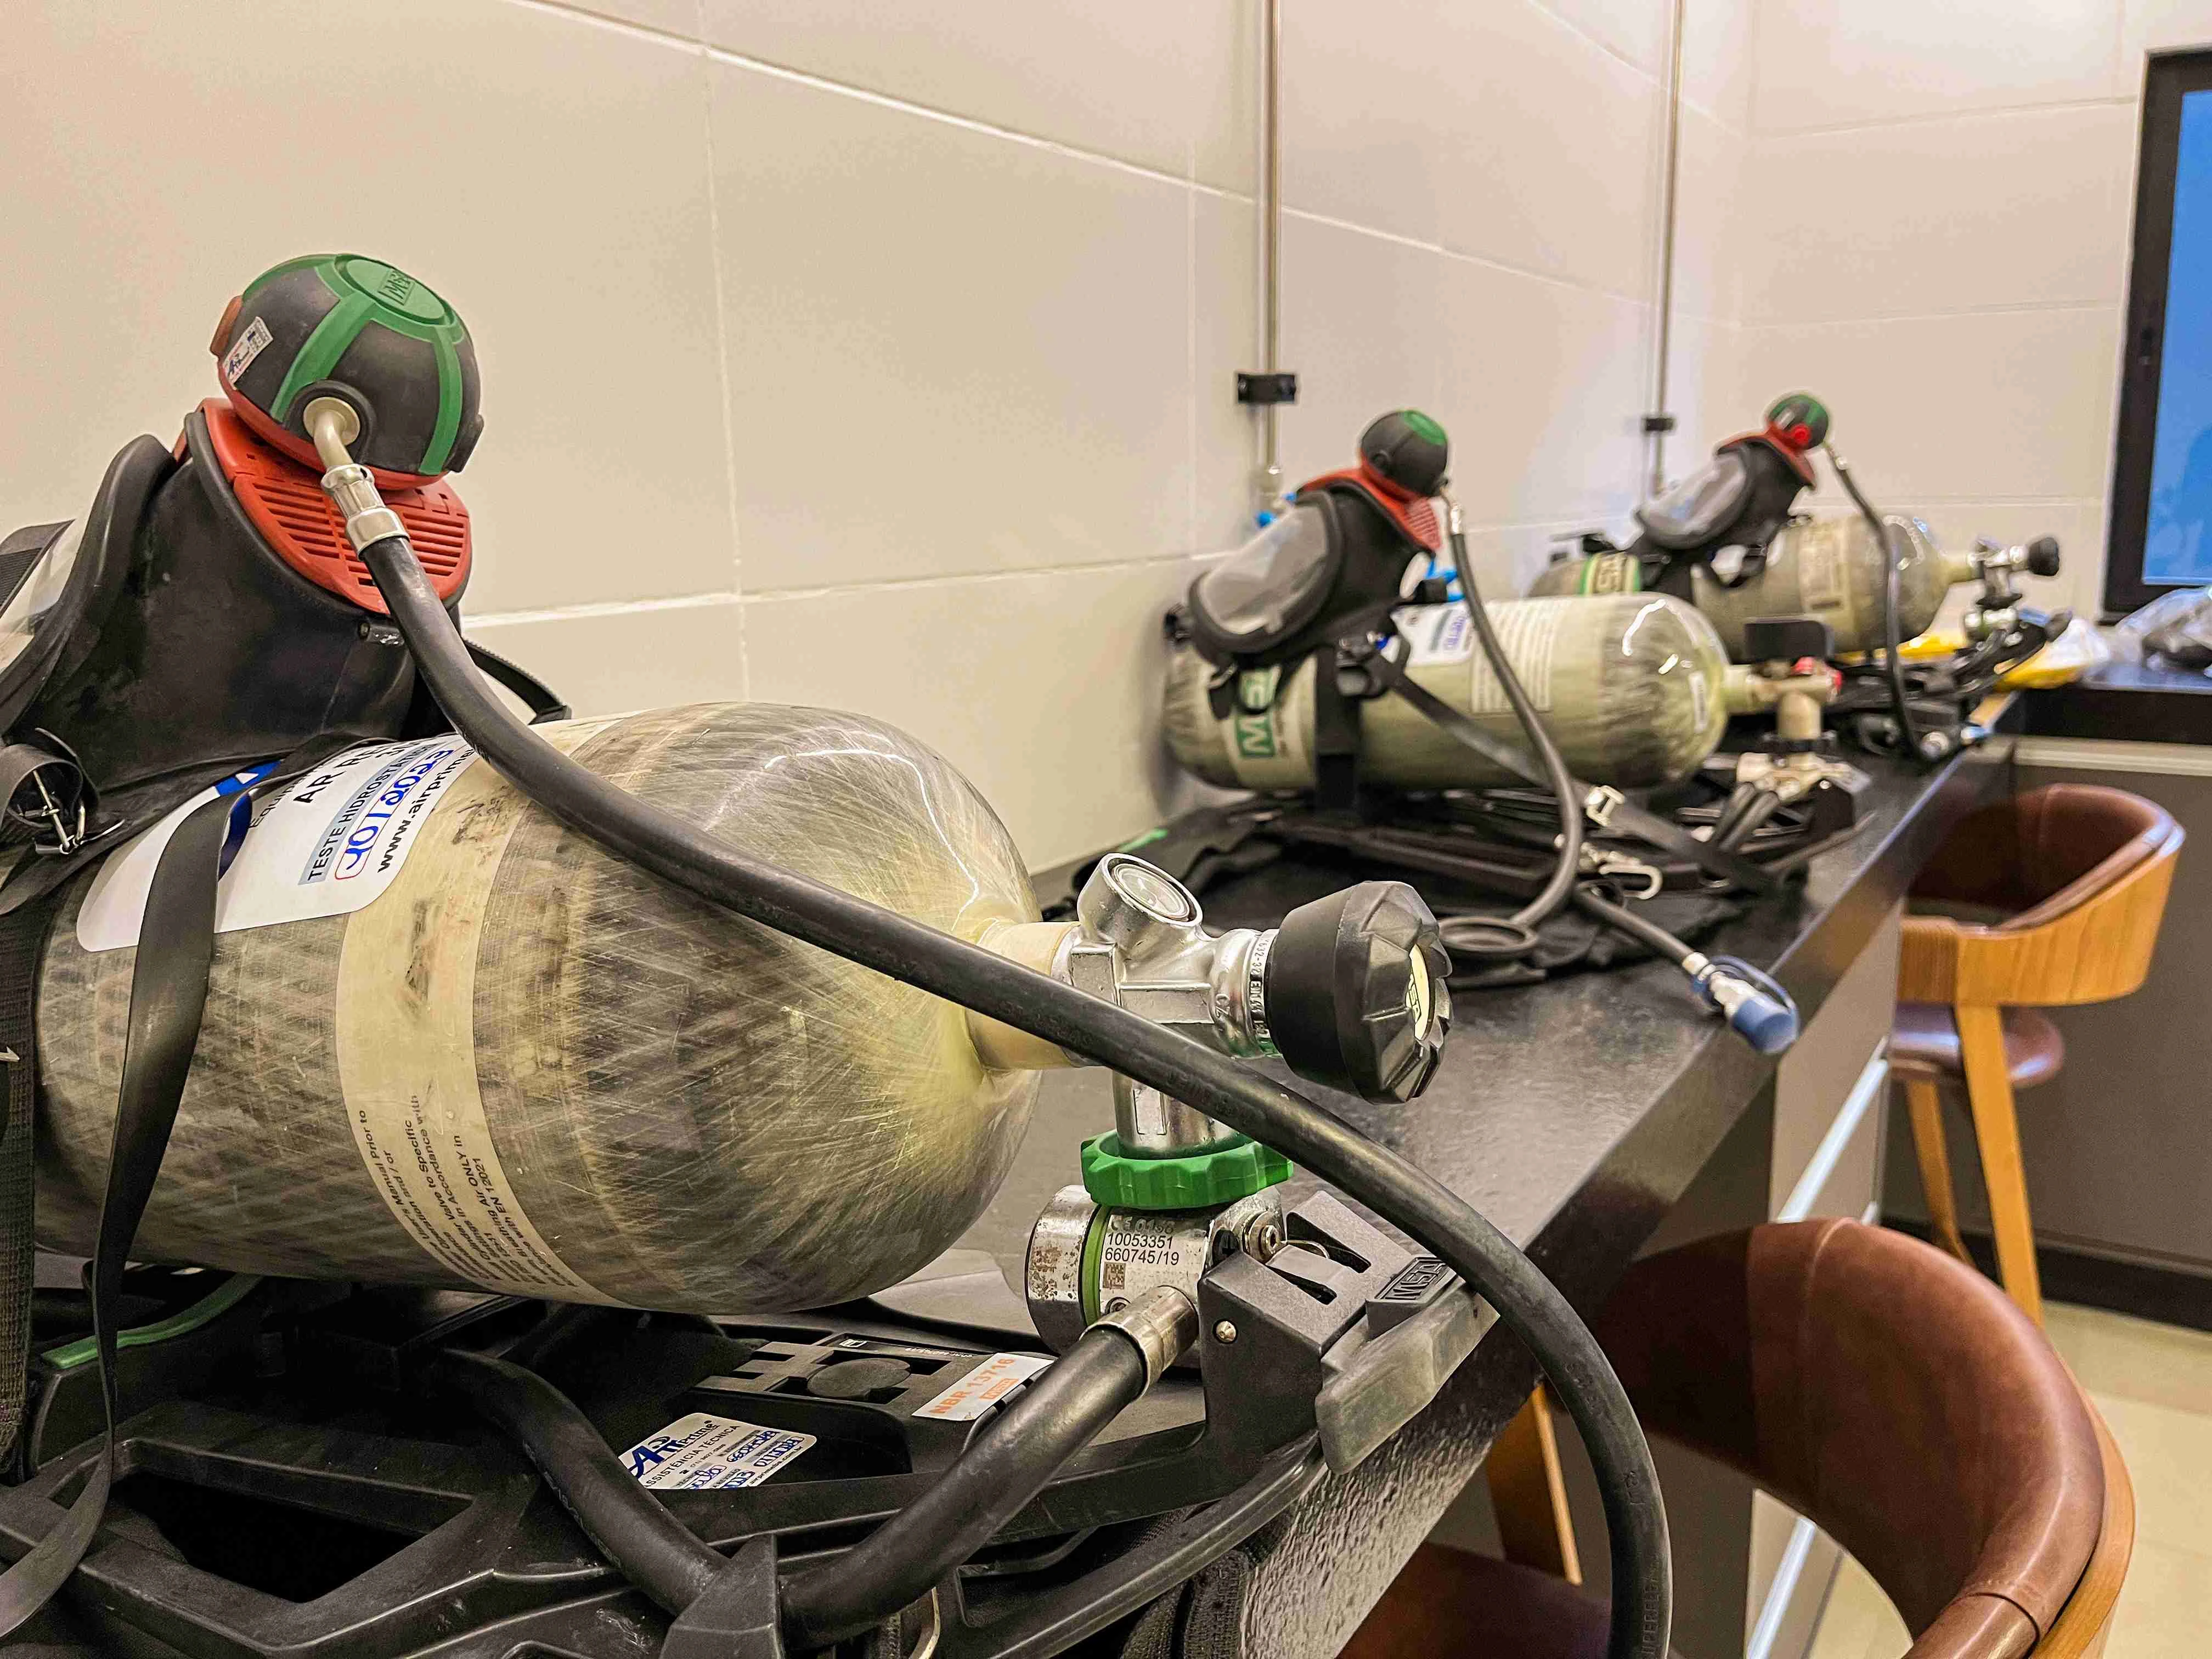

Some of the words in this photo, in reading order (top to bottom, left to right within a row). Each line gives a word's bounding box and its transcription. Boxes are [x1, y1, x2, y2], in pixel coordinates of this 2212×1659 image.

[293, 770, 347, 804] AR
[308, 826, 346, 881] TESTE
[359, 1110, 368, 1124] to
[364, 1127, 380, 1159] Prior
[405, 1120, 428, 1173] Specific
[454, 1135, 462, 1147] in
[383, 1150, 394, 1164] or
[420, 1128, 459, 1205] Accordance
[456, 1151, 478, 1187] ONLY
[375, 1163, 404, 1205] Manual
[393, 1176, 411, 1199] and
[426, 1176, 436, 1188] to
[472, 1158, 495, 1193] 12021
[434, 1192, 455, 1220] Valve
[476, 1190, 491, 1207] Air
[490, 1197, 506, 1214] EN
[456, 1207, 466, 1217] in
[1108, 1232, 1173, 1250] 10053351
[1104, 1246, 1180, 1266] 660745/19
[1384, 1262, 1445, 1300] MSA
[929, 1390, 973, 1414] NBR
